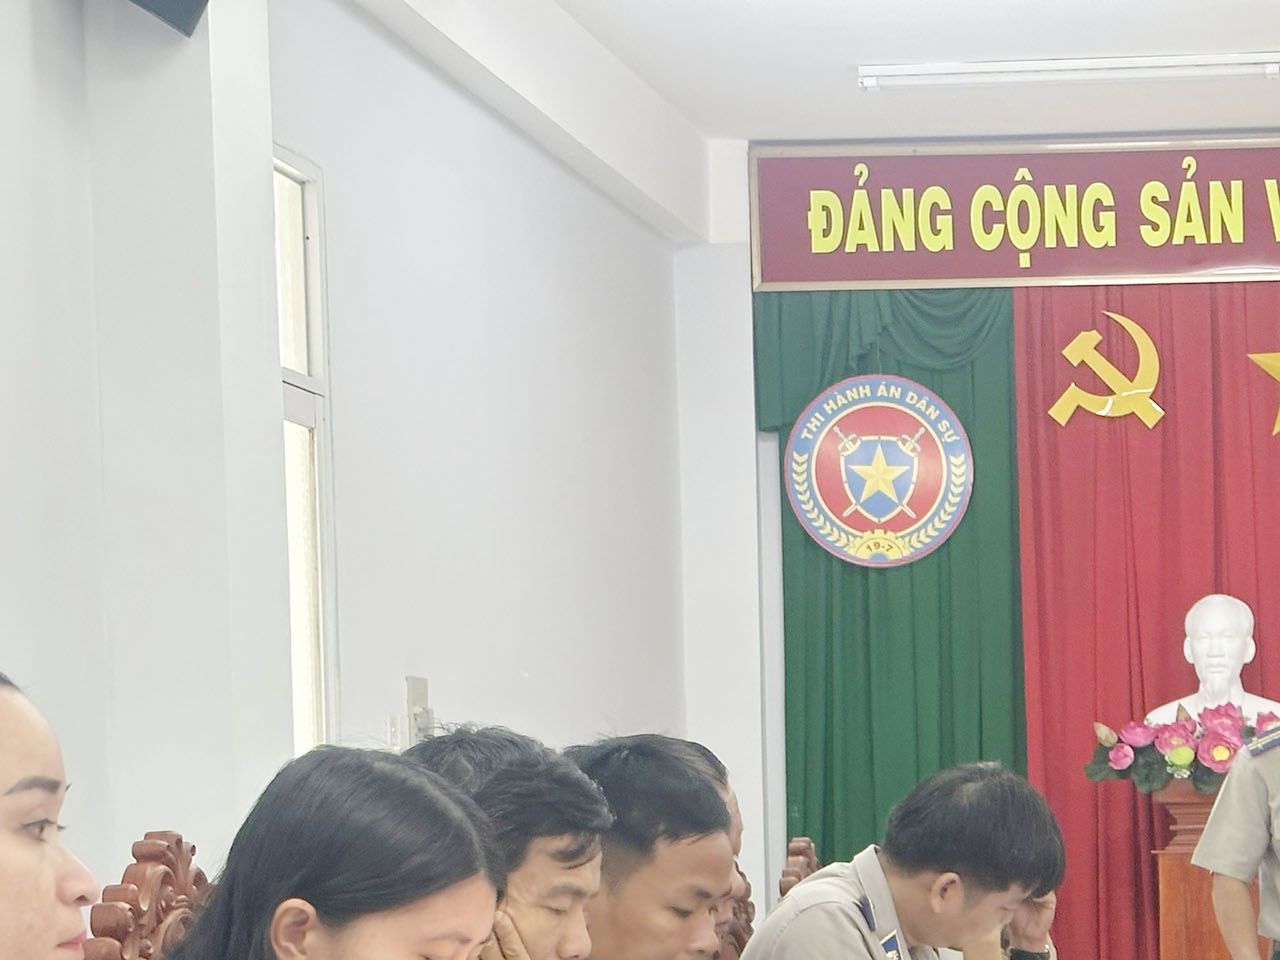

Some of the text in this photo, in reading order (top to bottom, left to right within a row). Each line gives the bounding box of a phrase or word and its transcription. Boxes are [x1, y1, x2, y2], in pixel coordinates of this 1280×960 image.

[808, 164, 953, 253] ĐẢNG
[970, 167, 1117, 268] CỘNG
[1140, 156, 1244, 247] SẢN
[800, 381, 960, 443] THI HÀNH ÁN DÂN SỰ
